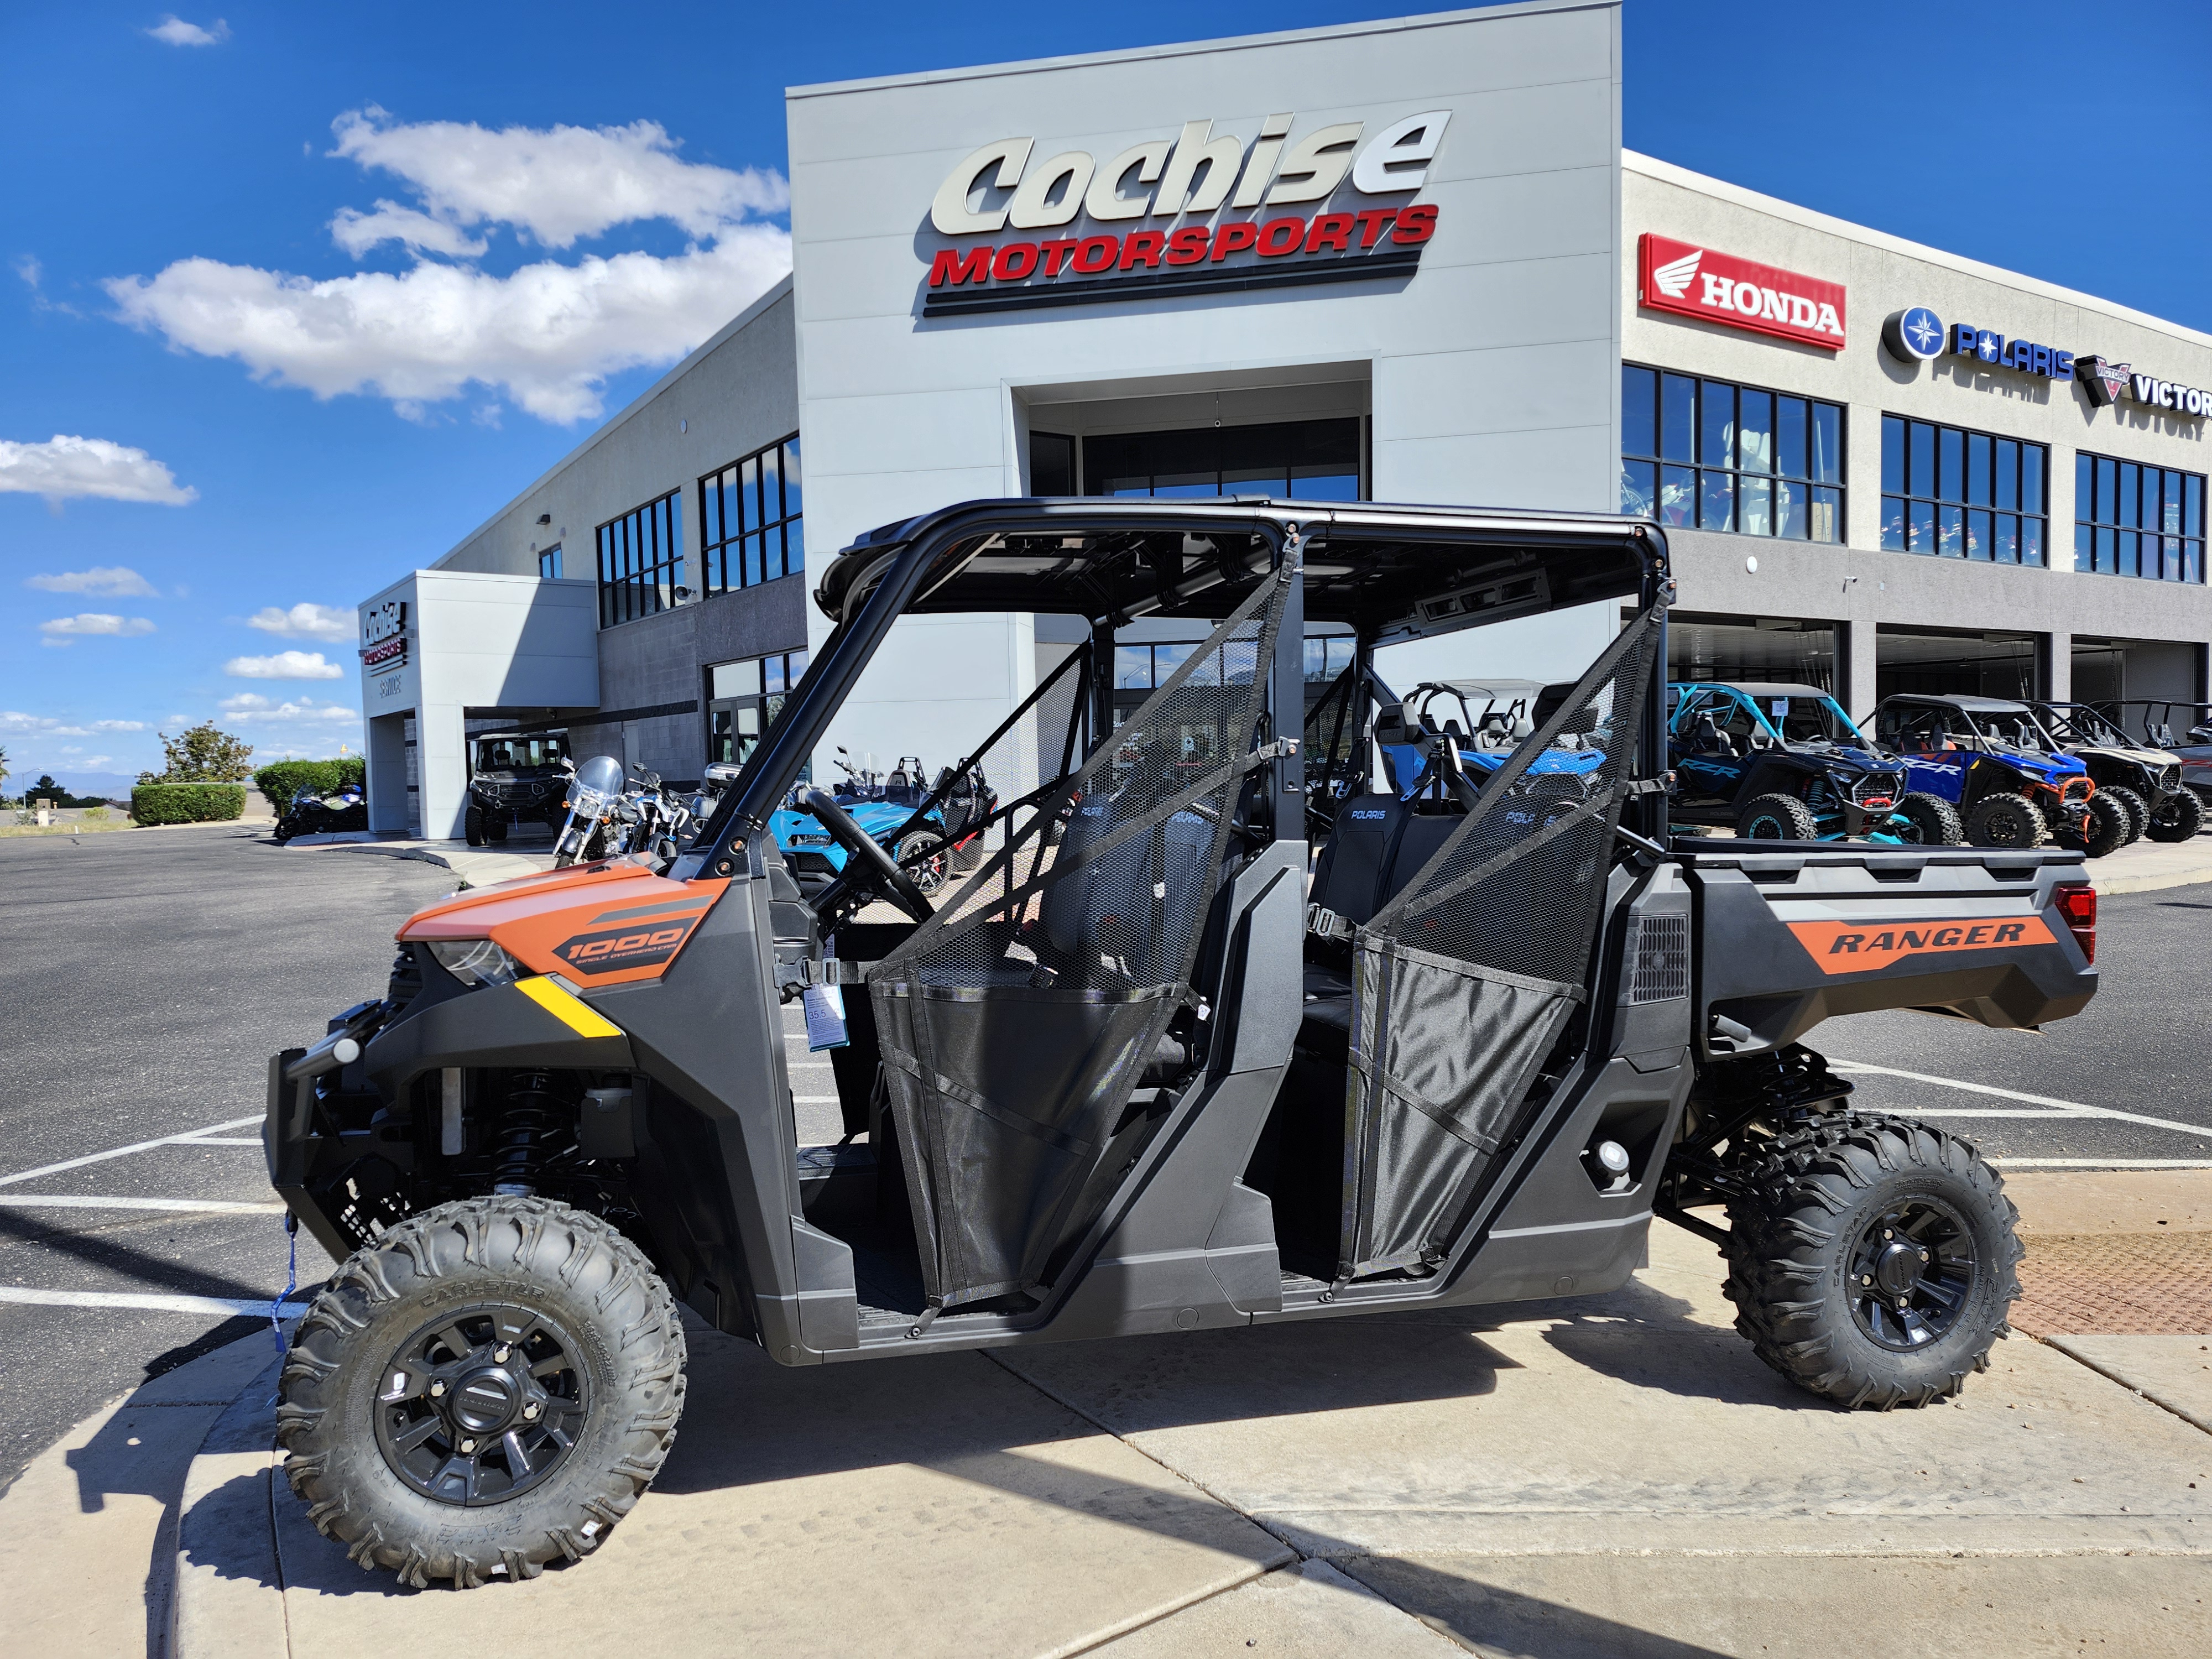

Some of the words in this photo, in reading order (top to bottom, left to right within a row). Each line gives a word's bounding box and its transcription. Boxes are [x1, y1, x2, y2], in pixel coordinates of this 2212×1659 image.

[931, 109, 1453, 235] Cochise
[928, 204, 1439, 287] MOTORSPORTS
[1701, 271, 1845, 337] HONDA
[1951, 323, 2074, 382] POLARIS
[2098, 366, 2129, 382] VICTORY
[364, 602, 401, 647] Cochise
[364, 638, 403, 665] MOTORSPORTS
[380, 674, 401, 699] SERVICE
[1677, 758, 1741, 779] RZR
[1900, 757, 1962, 776] RZR
[1351, 810, 1386, 819] POLARIS
[567, 928, 685, 960] 1000
[1828, 923, 2027, 955] RANGER
[576, 954, 609, 965] SINGLE
[610, 947, 658, 959] OVERHEAD
[657, 943, 678, 951] CAM
[808, 1009, 826, 1020] 35.5
[419, 1279, 545, 1310] CARLSTAR
